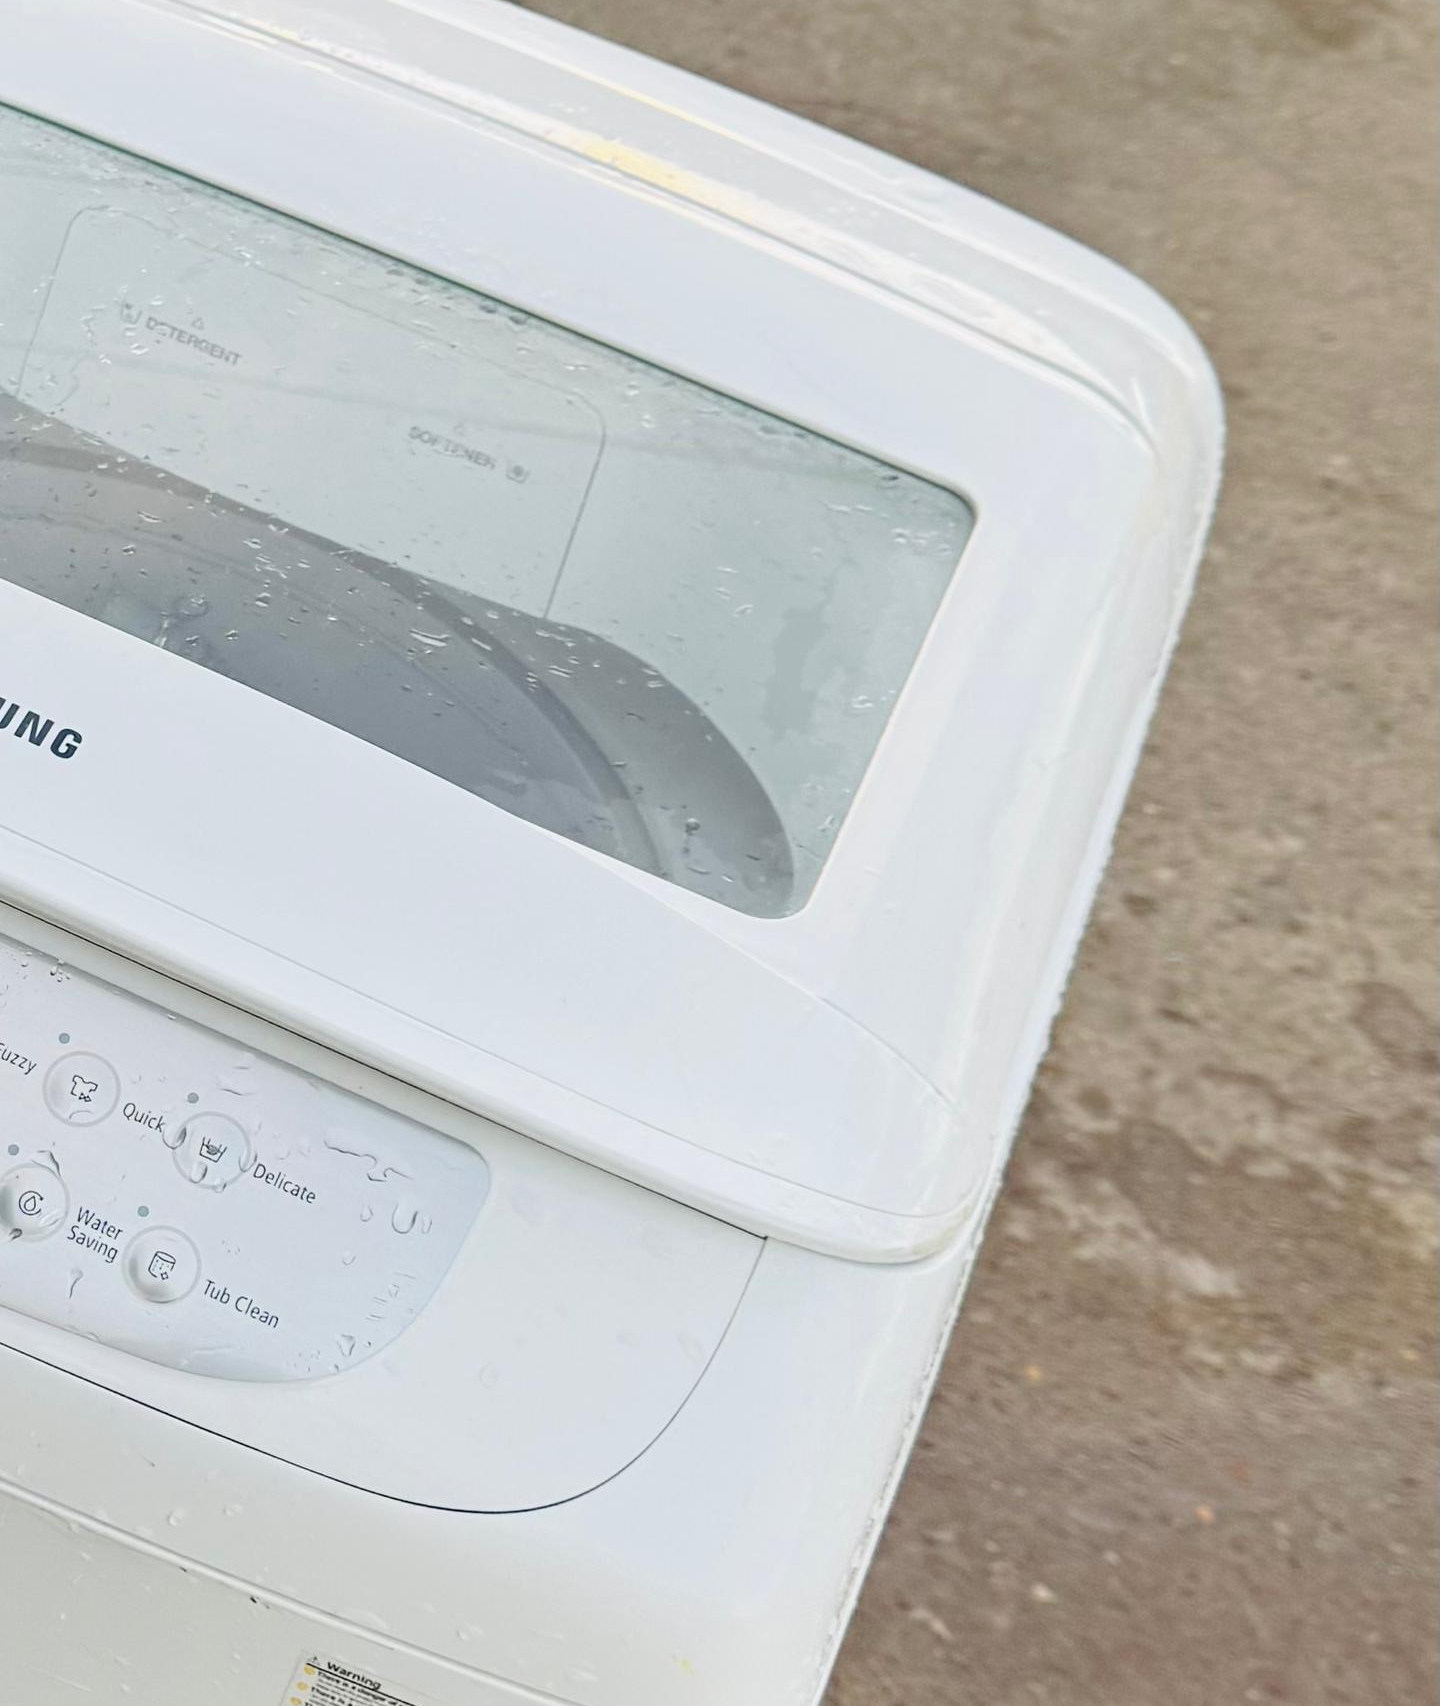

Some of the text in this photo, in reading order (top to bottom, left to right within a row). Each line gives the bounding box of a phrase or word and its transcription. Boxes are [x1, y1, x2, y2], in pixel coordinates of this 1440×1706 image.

[145, 316, 242, 366] DETERGENT
[123, 1102, 167, 1135] Quick
[253, 1162, 317, 1205] Delicate
[66, 1223, 118, 1265] Saving
[76, 1205, 124, 1242] Water
[204, 1278, 280, 1329] Tub Clean
[324, 1661, 382, 1691] Warning
